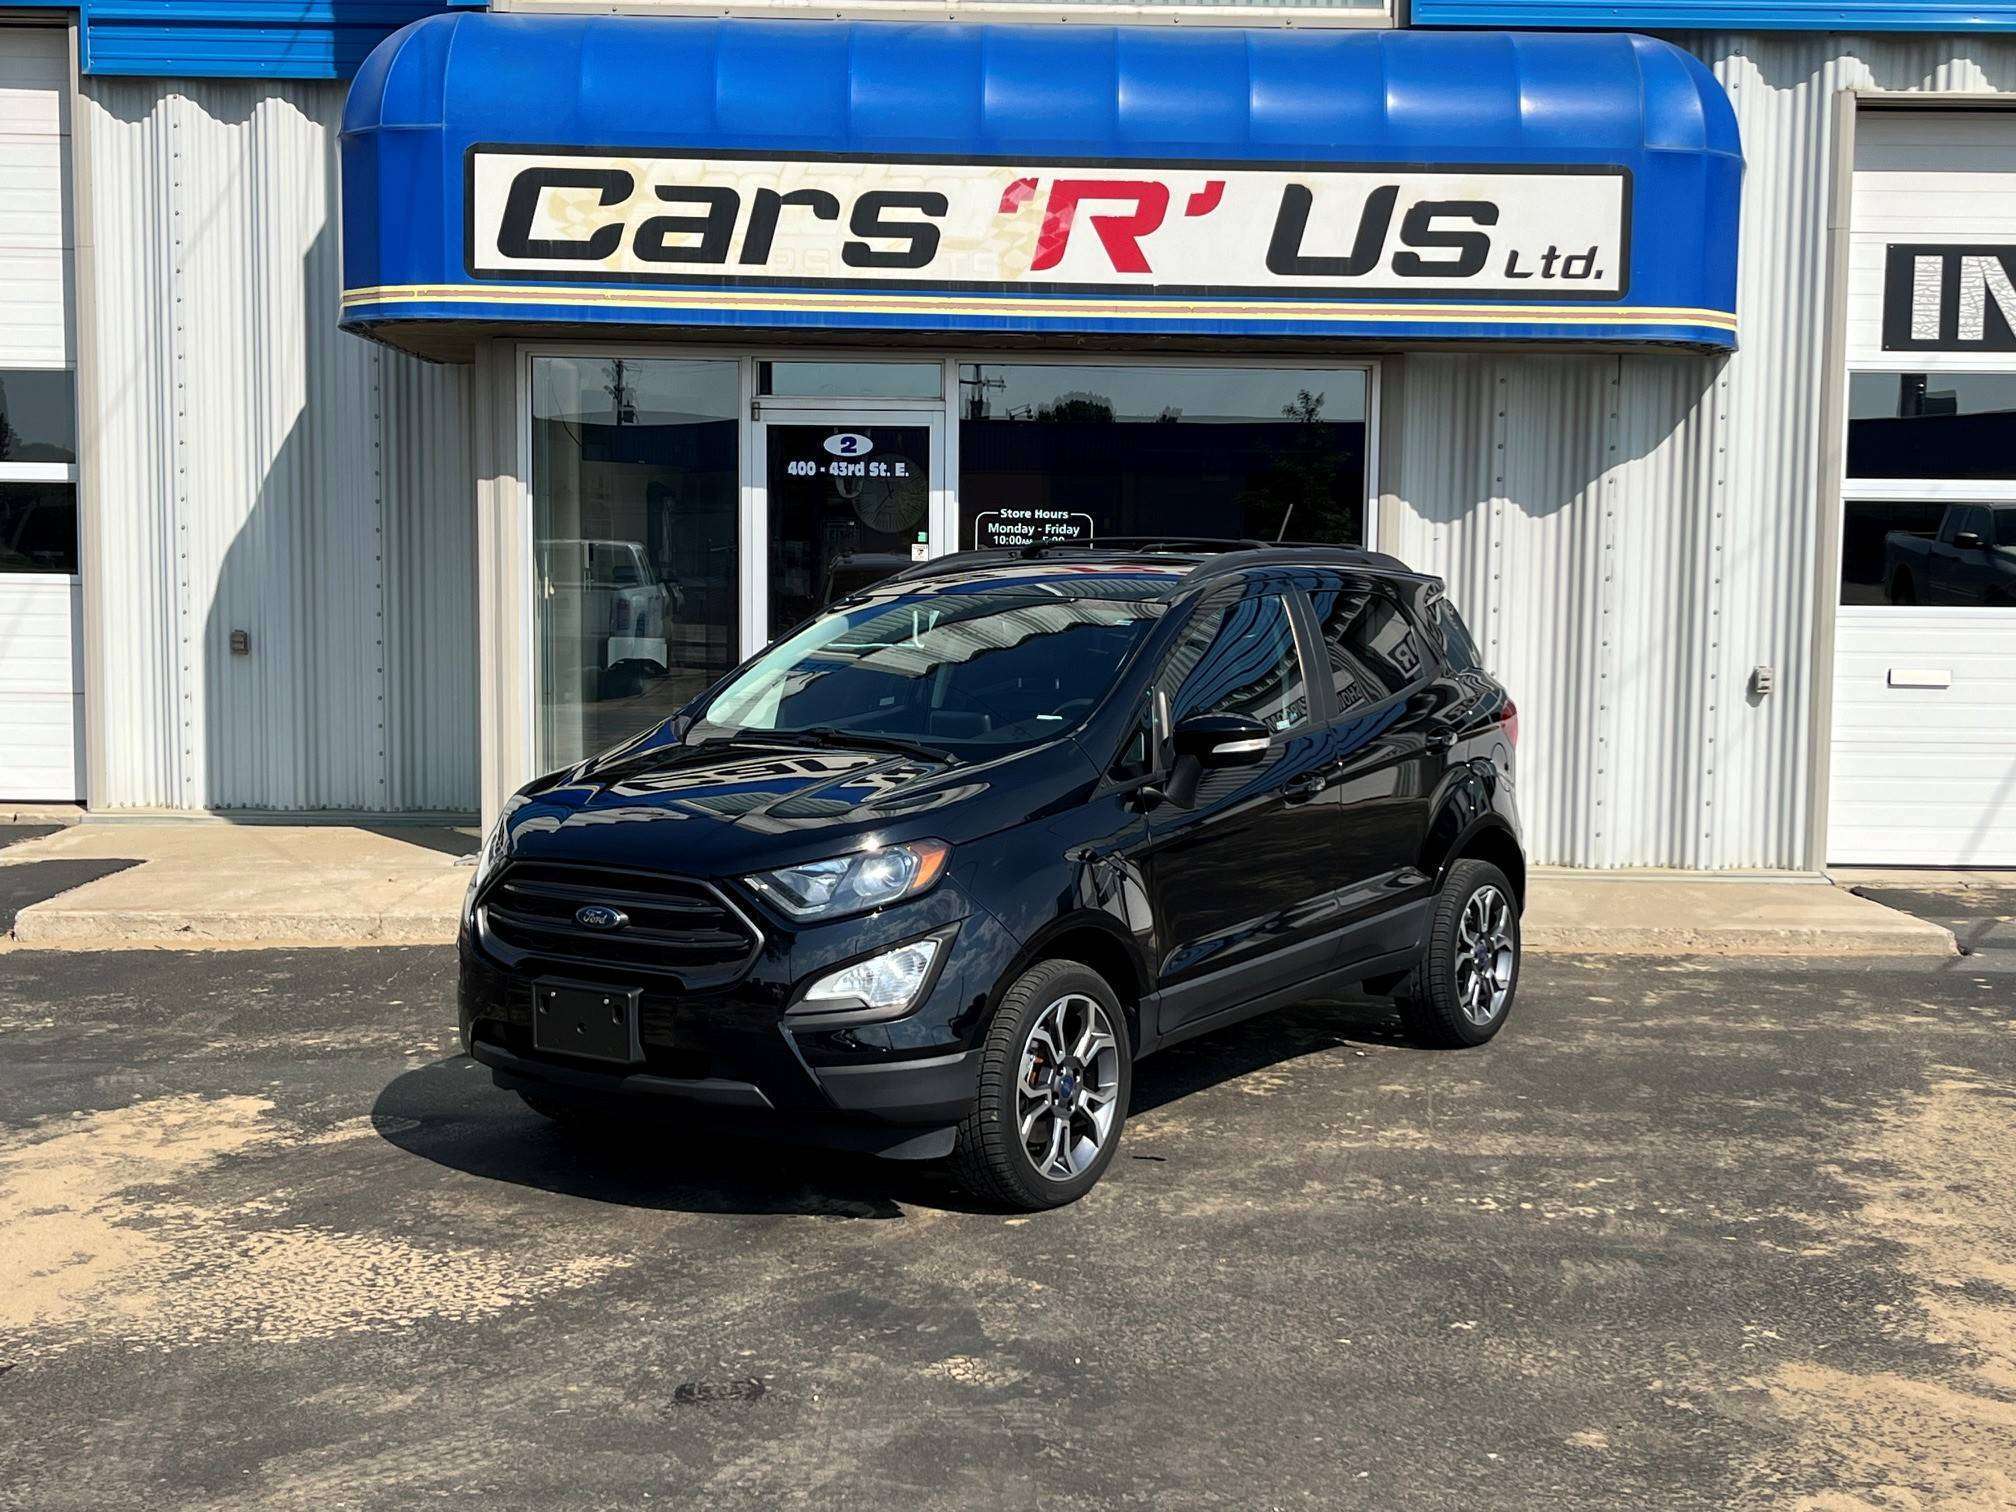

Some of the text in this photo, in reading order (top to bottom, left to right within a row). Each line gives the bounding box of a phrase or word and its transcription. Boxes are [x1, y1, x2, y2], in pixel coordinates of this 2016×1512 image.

[497, 166, 949, 270] Cars
[1265, 184, 1500, 277] Us
[1504, 245, 1603, 280] Ltd.
[840, 436, 858, 453] 2
[787, 461, 816, 476] 400
[829, 461, 865, 477] 43rd
[869, 461, 891, 477] St.
[895, 462, 910, 477] E.
[1000, 508, 1069, 519] Store Hours
[987, 522, 1035, 537] Monday
[1045, 523, 1080, 538] Friday
[583, 909, 608, 924] Ford
